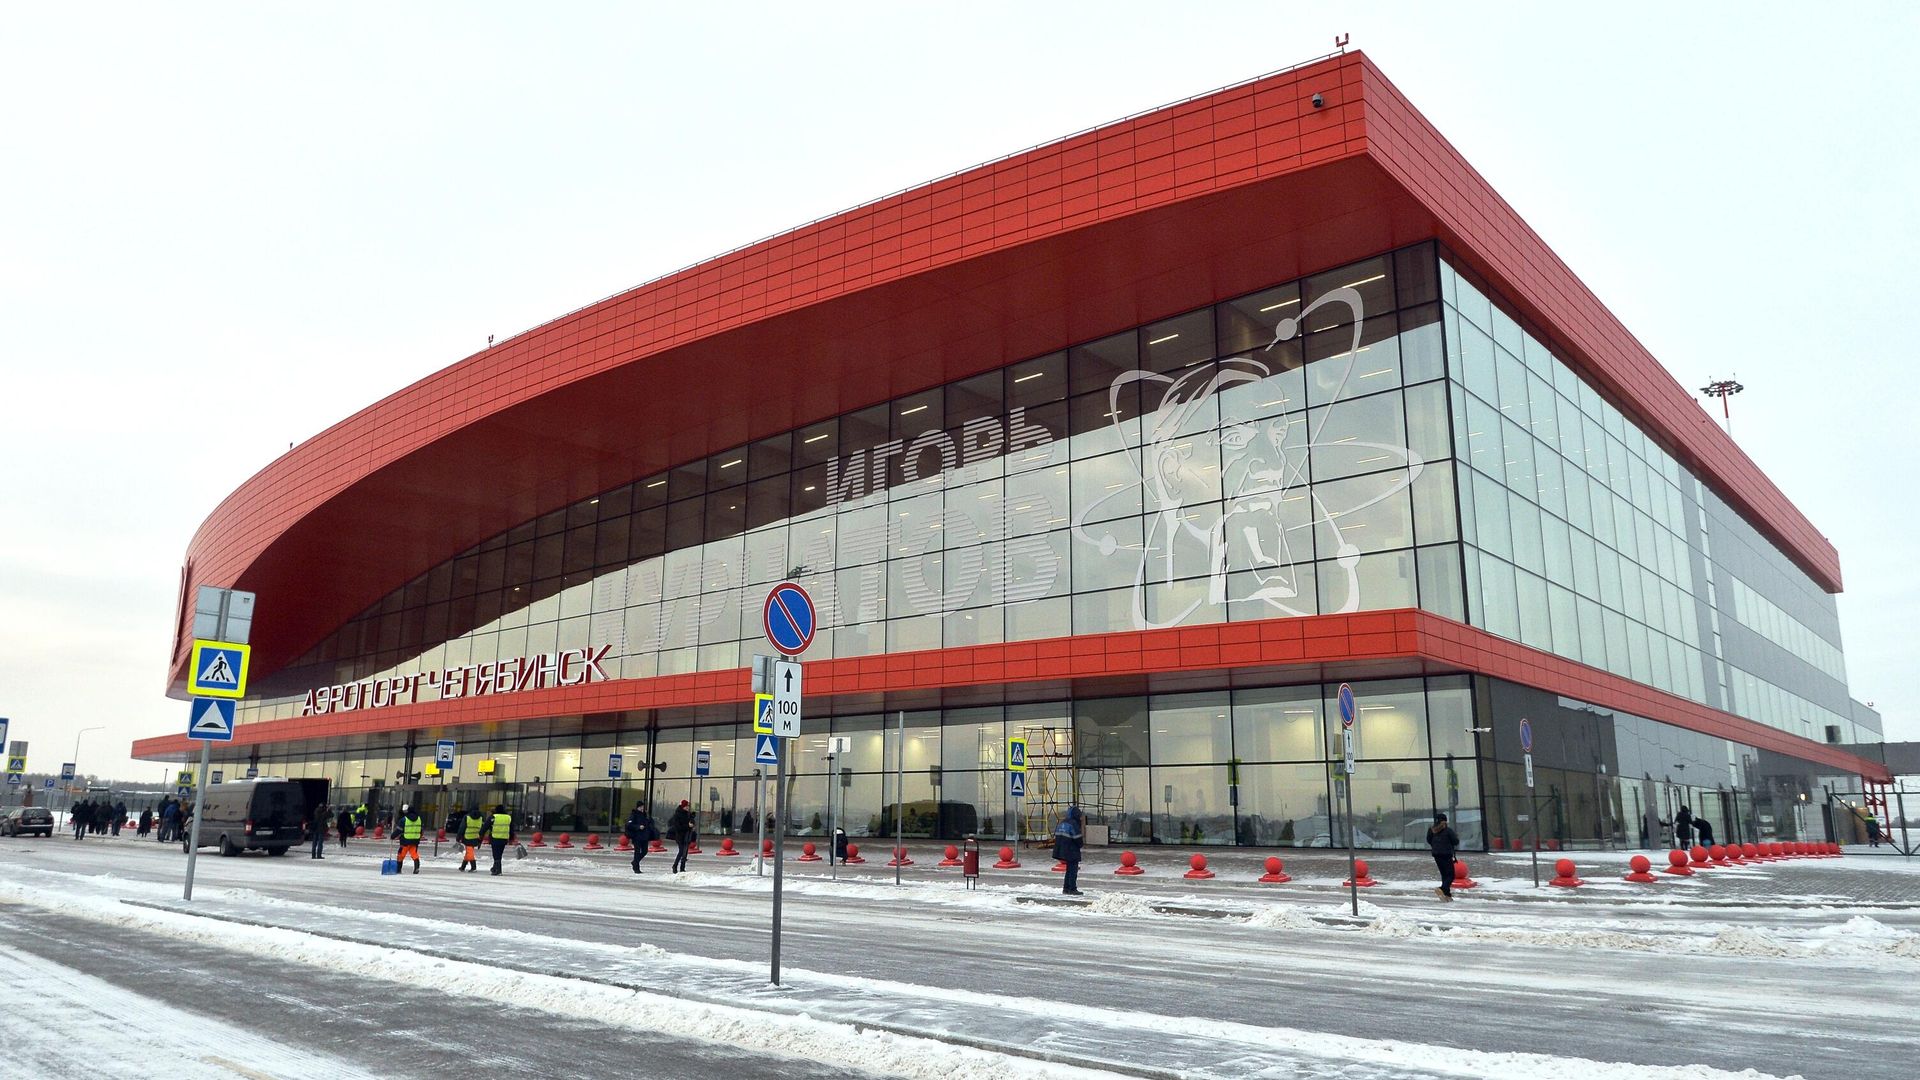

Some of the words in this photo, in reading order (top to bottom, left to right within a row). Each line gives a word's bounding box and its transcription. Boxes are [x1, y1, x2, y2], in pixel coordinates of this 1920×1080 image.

[826, 406, 1054, 508] ИГОРЬ
[597, 491, 1059, 658] КУРЧАТОВ
[302, 672, 426, 717] АЭРОПОРТ
[427, 643, 612, 700] ЧЕЛЯБИНСК
[778, 700, 797, 715] 100
